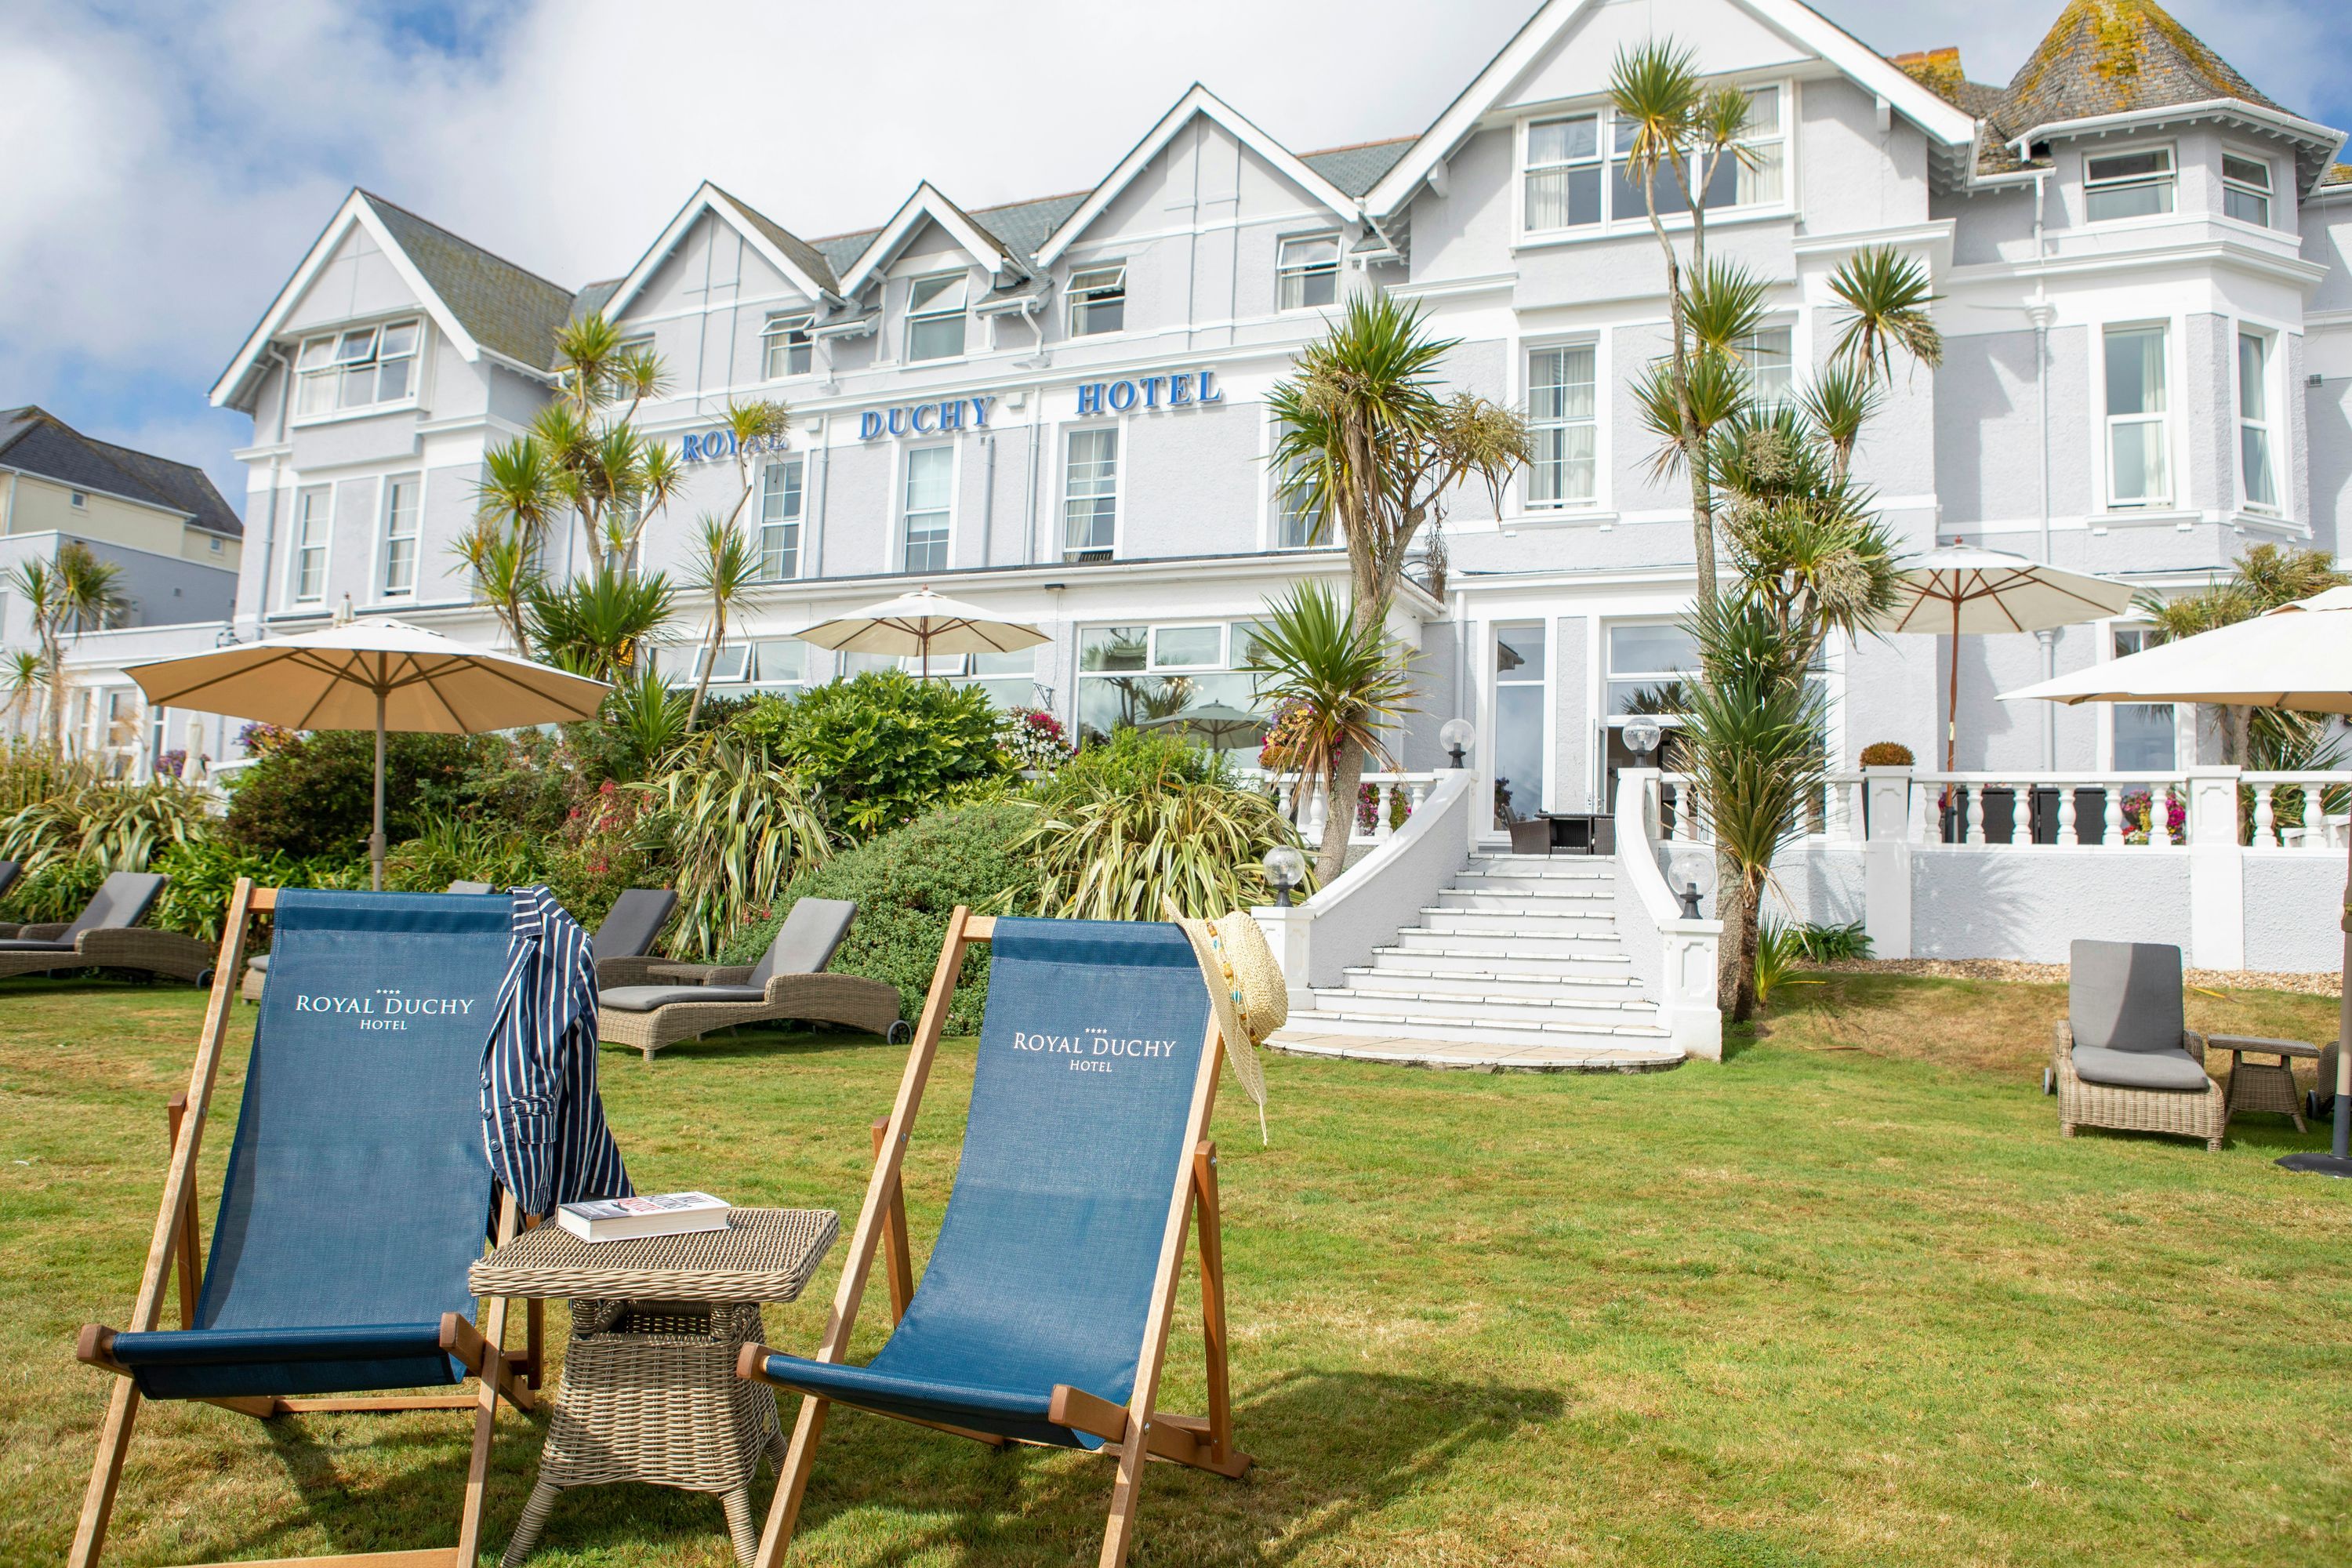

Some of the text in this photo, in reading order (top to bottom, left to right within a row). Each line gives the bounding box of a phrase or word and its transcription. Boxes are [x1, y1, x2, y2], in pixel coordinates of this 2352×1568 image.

[858, 396, 996, 441] DUCHY
[1075, 370, 1223, 415] HOTEL
[296, 995, 475, 1014] ROYAL DUCHY
[360, 1019, 408, 1030] HOTEL
[1014, 1033, 1177, 1058] ROYAL DUCHY
[1069, 1060, 1112, 1073] HOTEL
